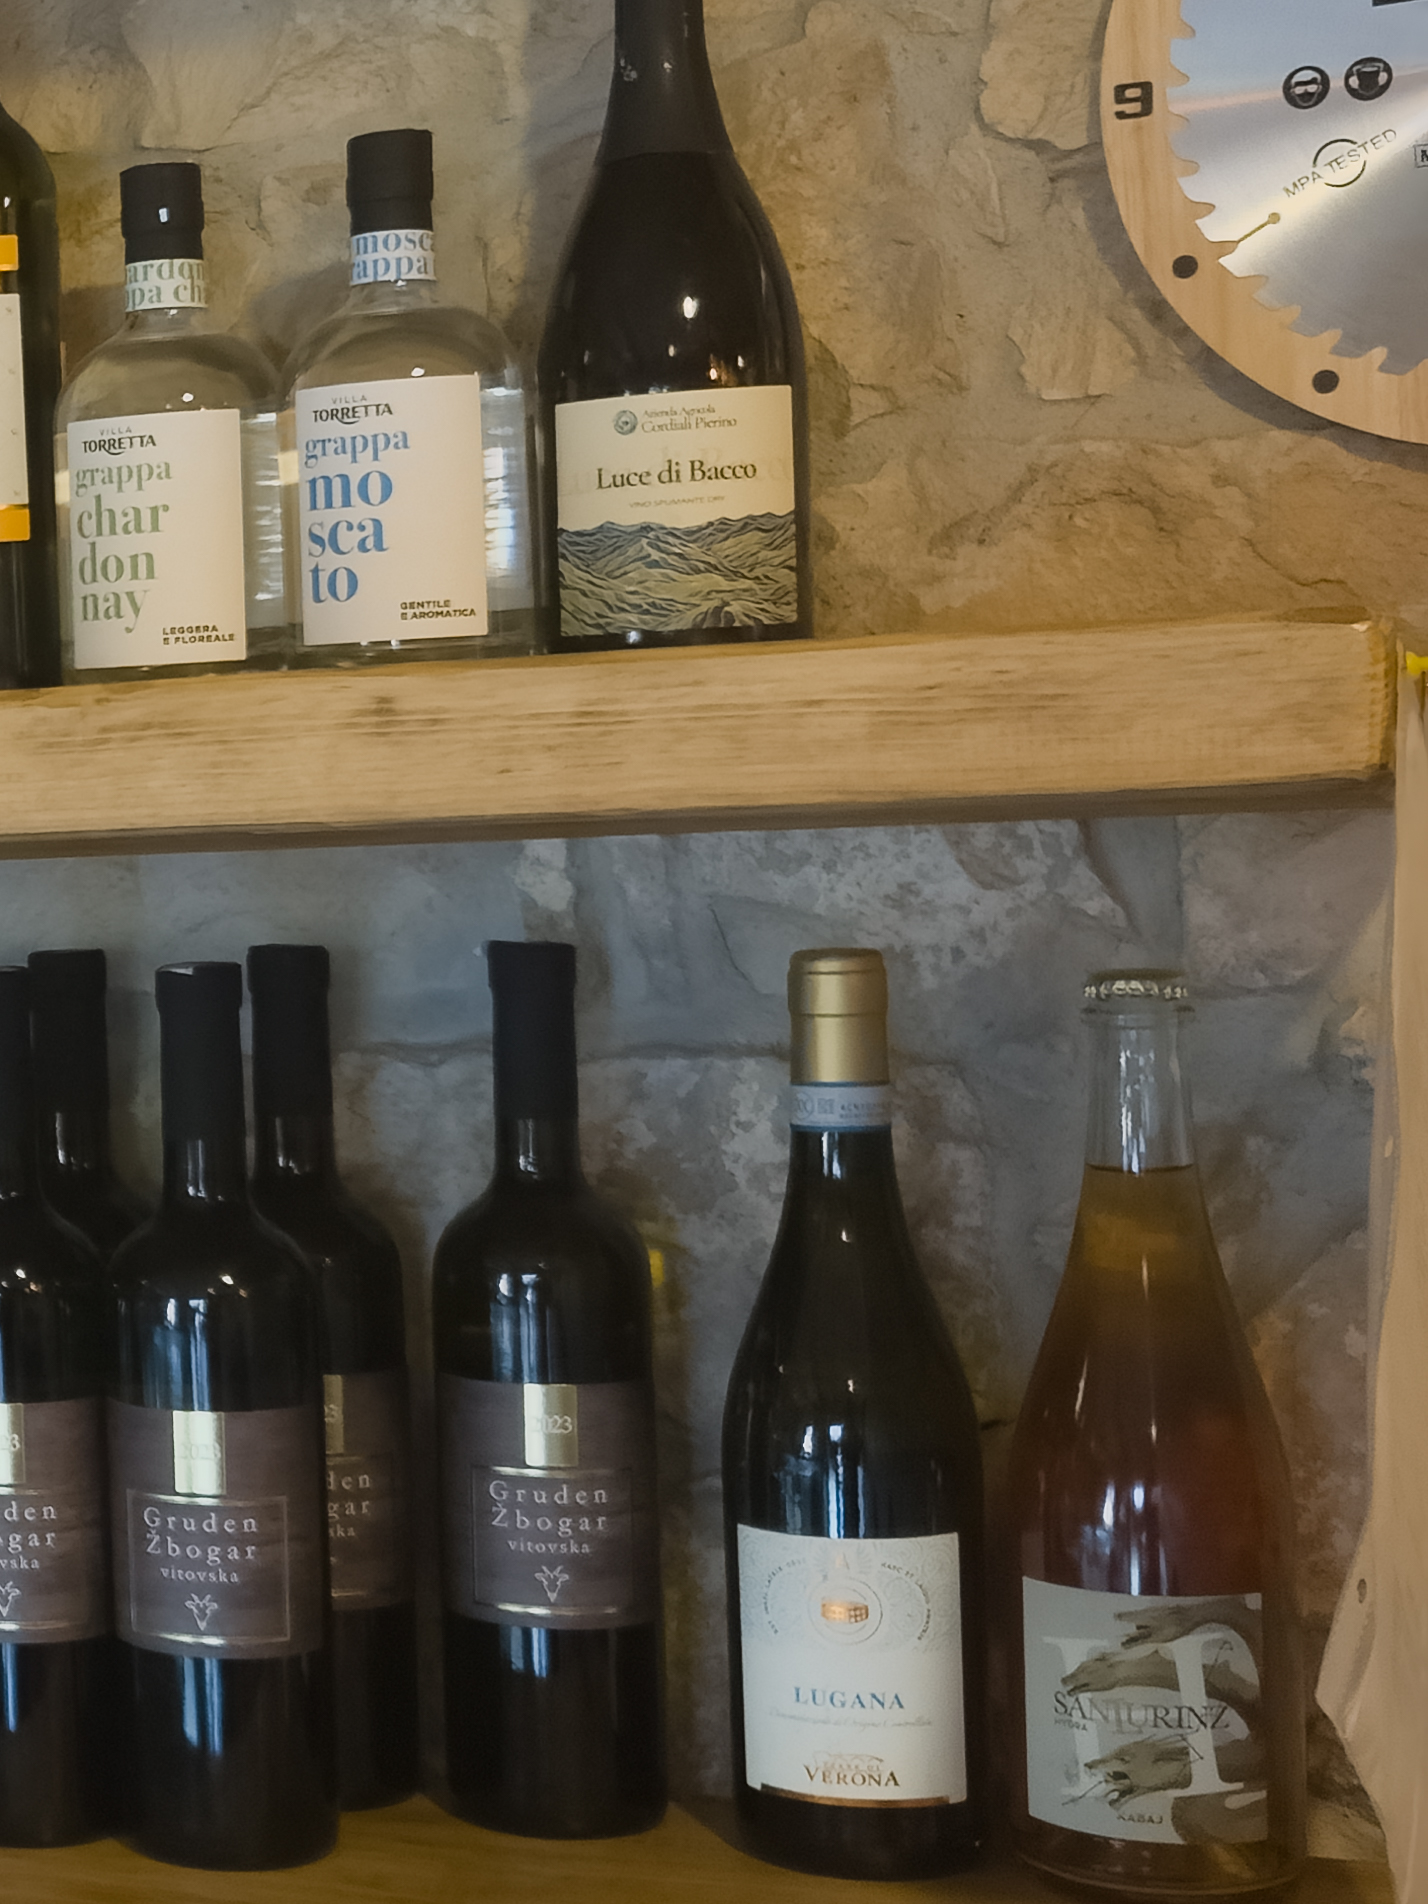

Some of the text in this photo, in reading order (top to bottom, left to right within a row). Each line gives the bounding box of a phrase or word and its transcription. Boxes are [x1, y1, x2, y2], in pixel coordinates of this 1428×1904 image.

[1111, 80, 1154, 122] 9
[1281, 128, 1398, 200] MPA TESTED
[311, 401, 393, 426] TORRETTA
[695, 414, 738, 431] Pierino
[82, 433, 157, 457] TORRETTA
[303, 428, 410, 470] grappa
[75, 459, 173, 495] grappa
[596, 457, 758, 490] Luce di Bacco
[306, 470, 393, 512] mo
[77, 493, 170, 540] char
[306, 517, 390, 559] sca
[79, 540, 157, 586] don
[309, 561, 359, 606] to
[80, 587, 151, 635] nay
[399, 599, 451, 612] GENTILE
[409, 607, 477, 620] AROMATICA
[162, 624, 220, 637] LEGGERA
[173, 632, 236, 646] FLOREALE
[488, 1478, 609, 1507] Gruden
[142, 1505, 259, 1533] Gruden
[158, 1564, 239, 1584] vitovska
[792, 1685, 906, 1711] LUGANA
[801, 1763, 901, 1789] VERONA
